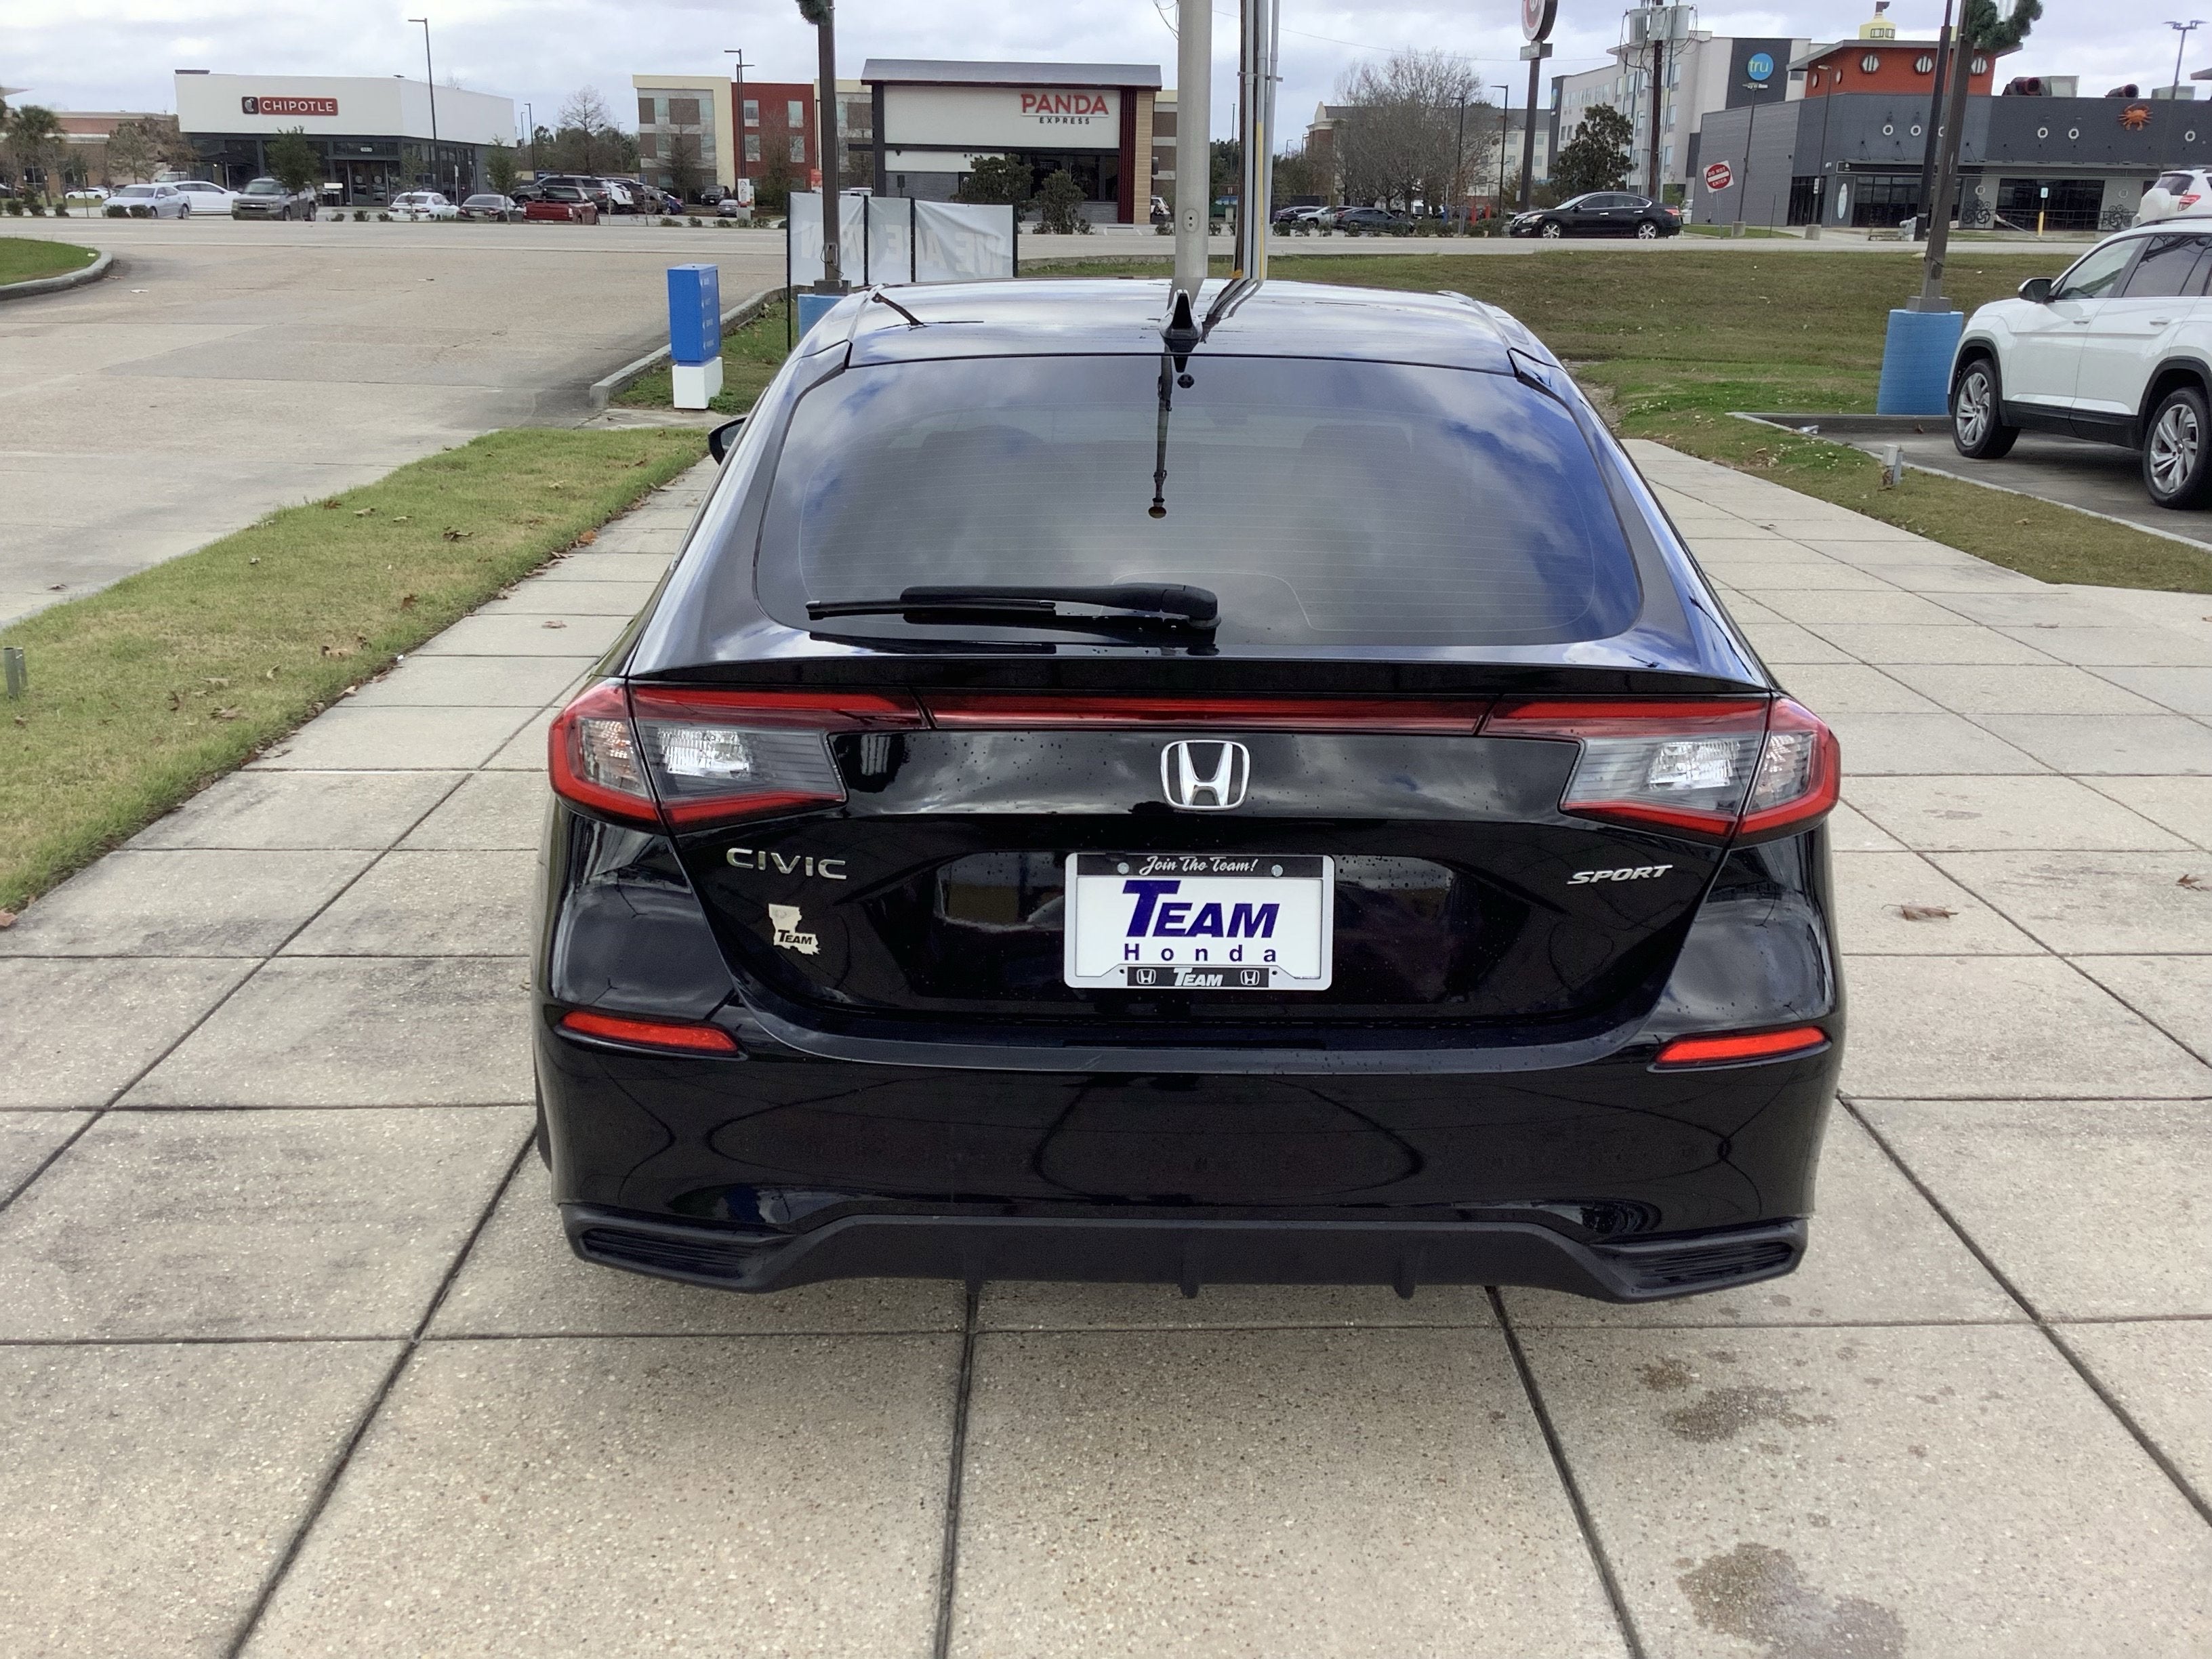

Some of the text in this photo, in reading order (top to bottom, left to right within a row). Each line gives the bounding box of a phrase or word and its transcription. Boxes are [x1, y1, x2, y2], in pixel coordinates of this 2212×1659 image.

[1748, 59, 1769, 73] tru
[262, 100, 334, 112] CHIPOTLE
[1021, 94, 1109, 115] PANDA
[1040, 117, 1090, 125] EXPRESS
[726, 847, 847, 880] CIVIC
[1139, 855, 1259, 876] Join The Team!
[1566, 864, 1674, 885] SPORT
[1122, 880, 1281, 939] TEAM
[777, 929, 813, 945] TEAM
[1124, 943, 1277, 962] Honda
[1173, 967, 1223, 987] TEAM
